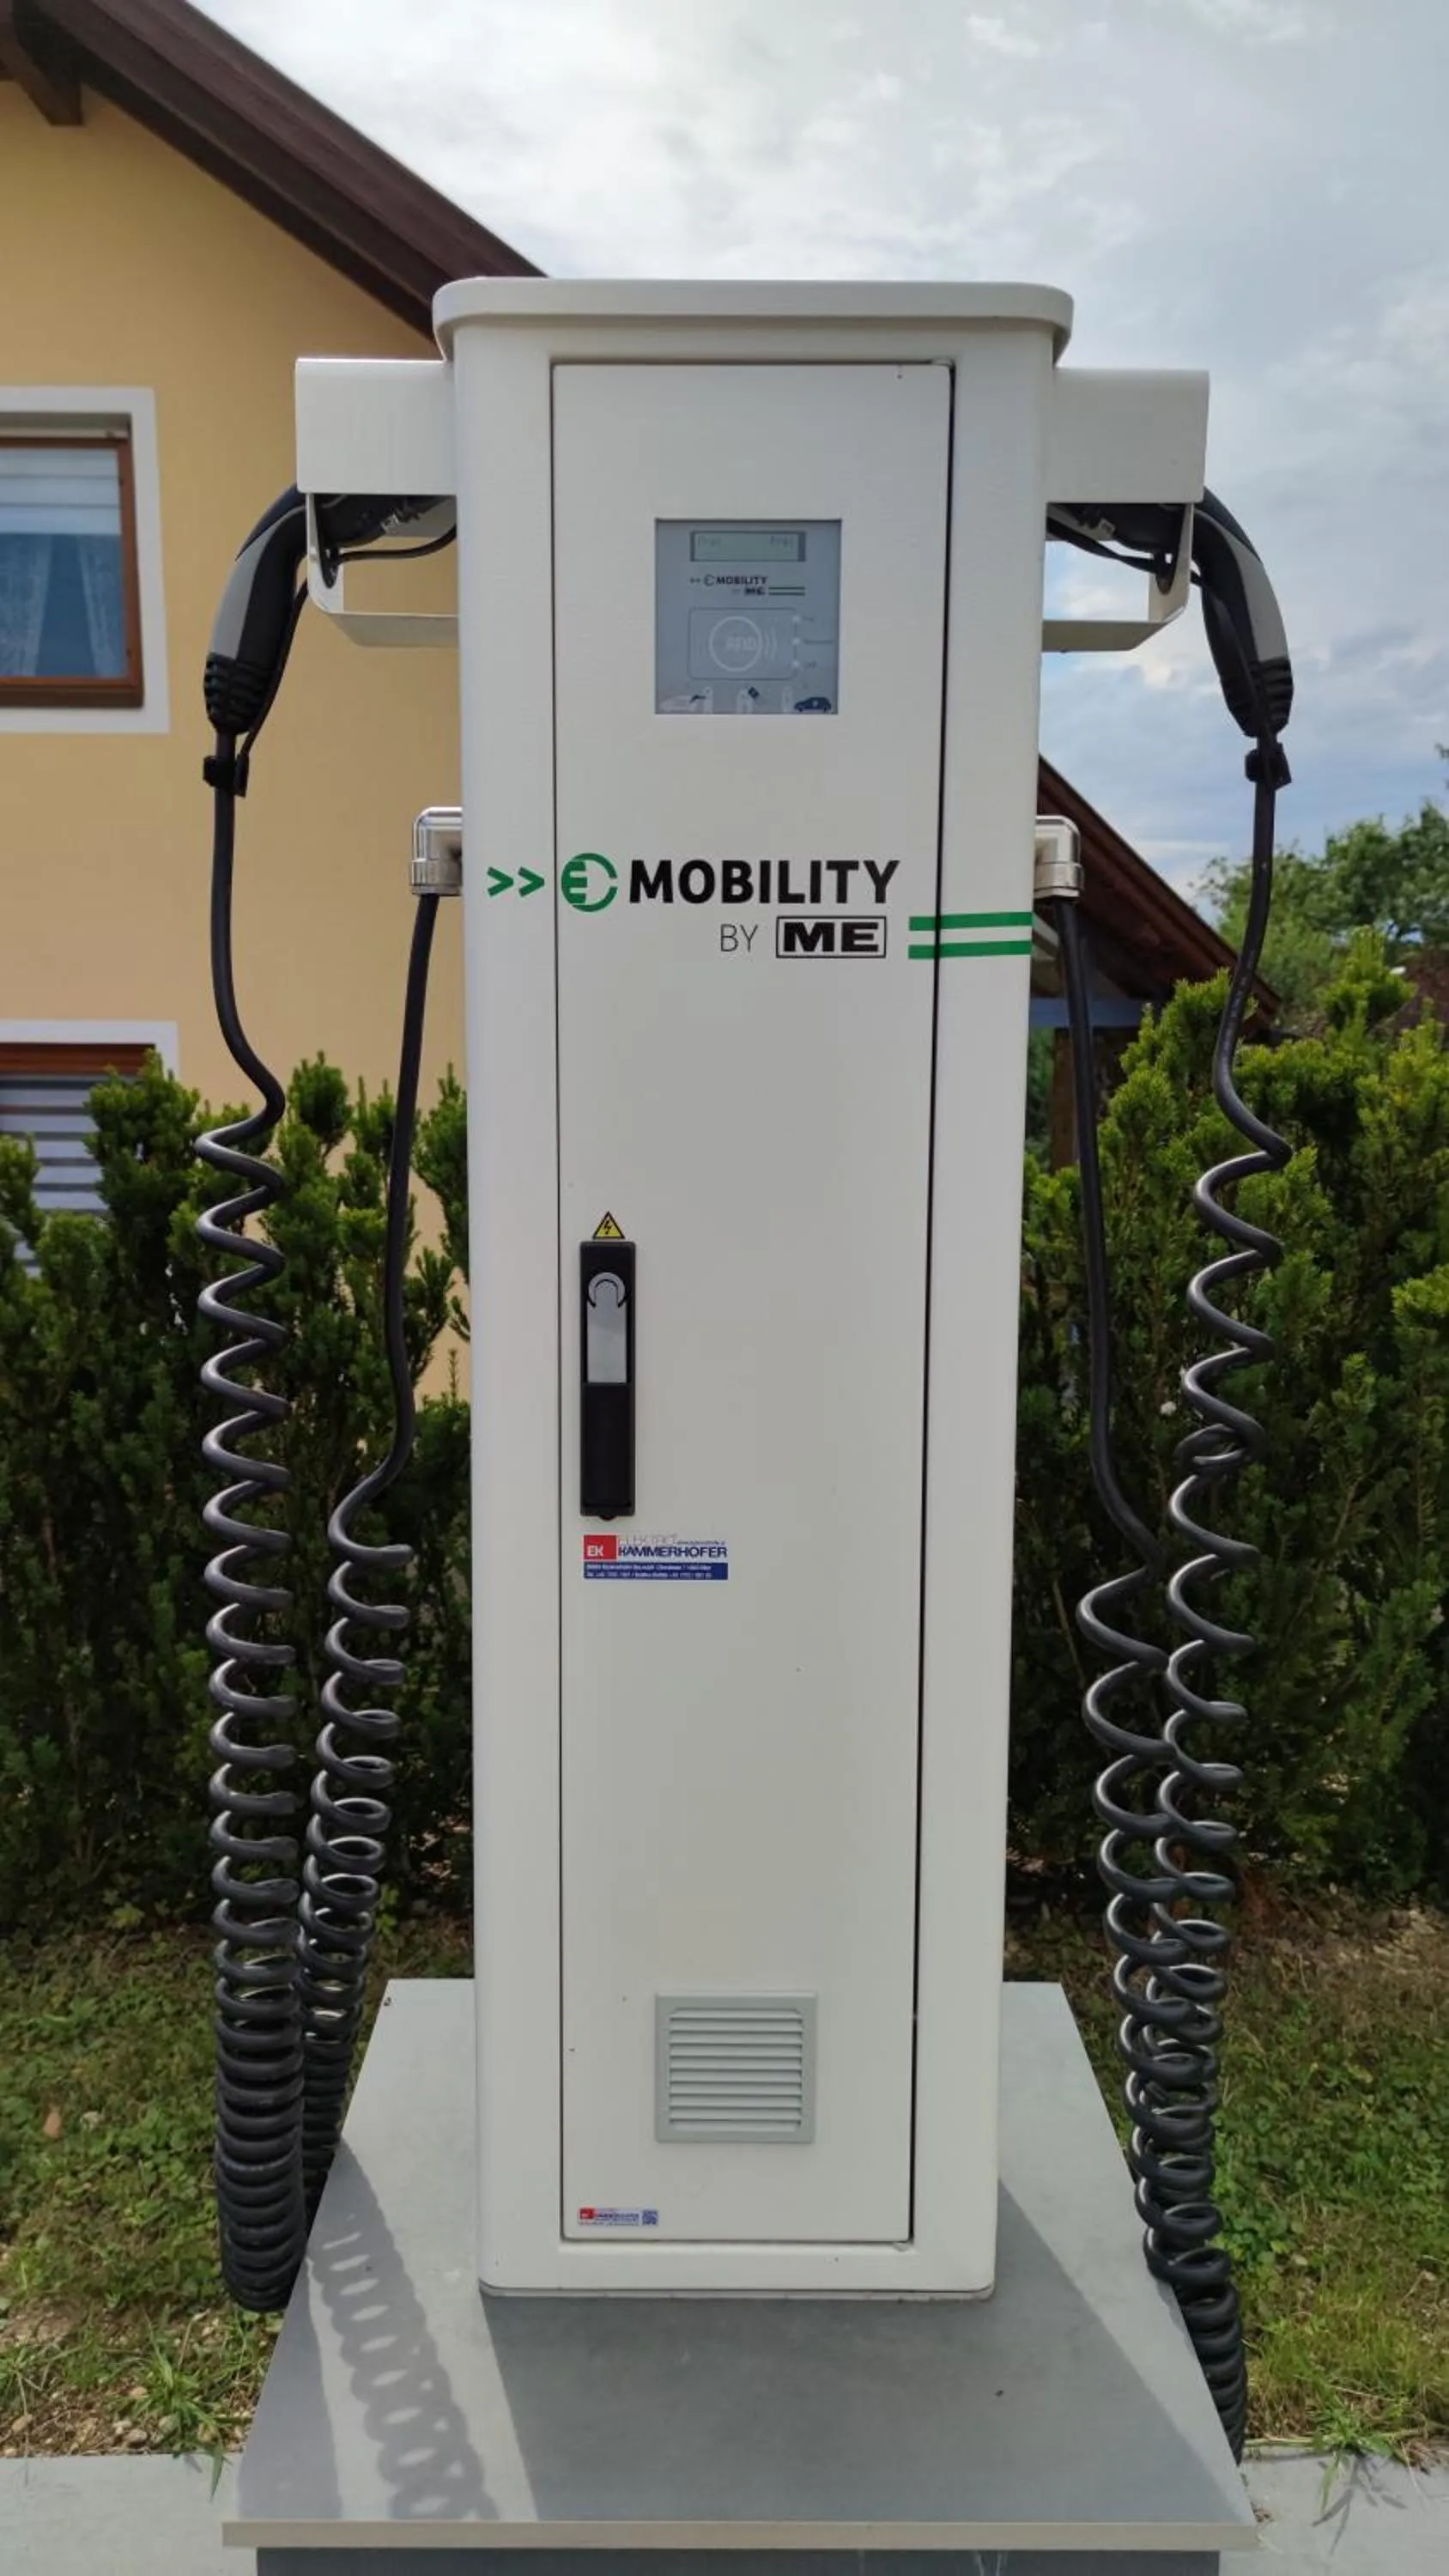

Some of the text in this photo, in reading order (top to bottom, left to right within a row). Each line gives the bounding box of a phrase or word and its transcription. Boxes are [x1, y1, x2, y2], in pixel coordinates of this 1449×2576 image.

[629, 860, 900, 904] MOBILITY
[720, 921, 880, 952] BY ME
[587, 1546, 603, 1557] EK
